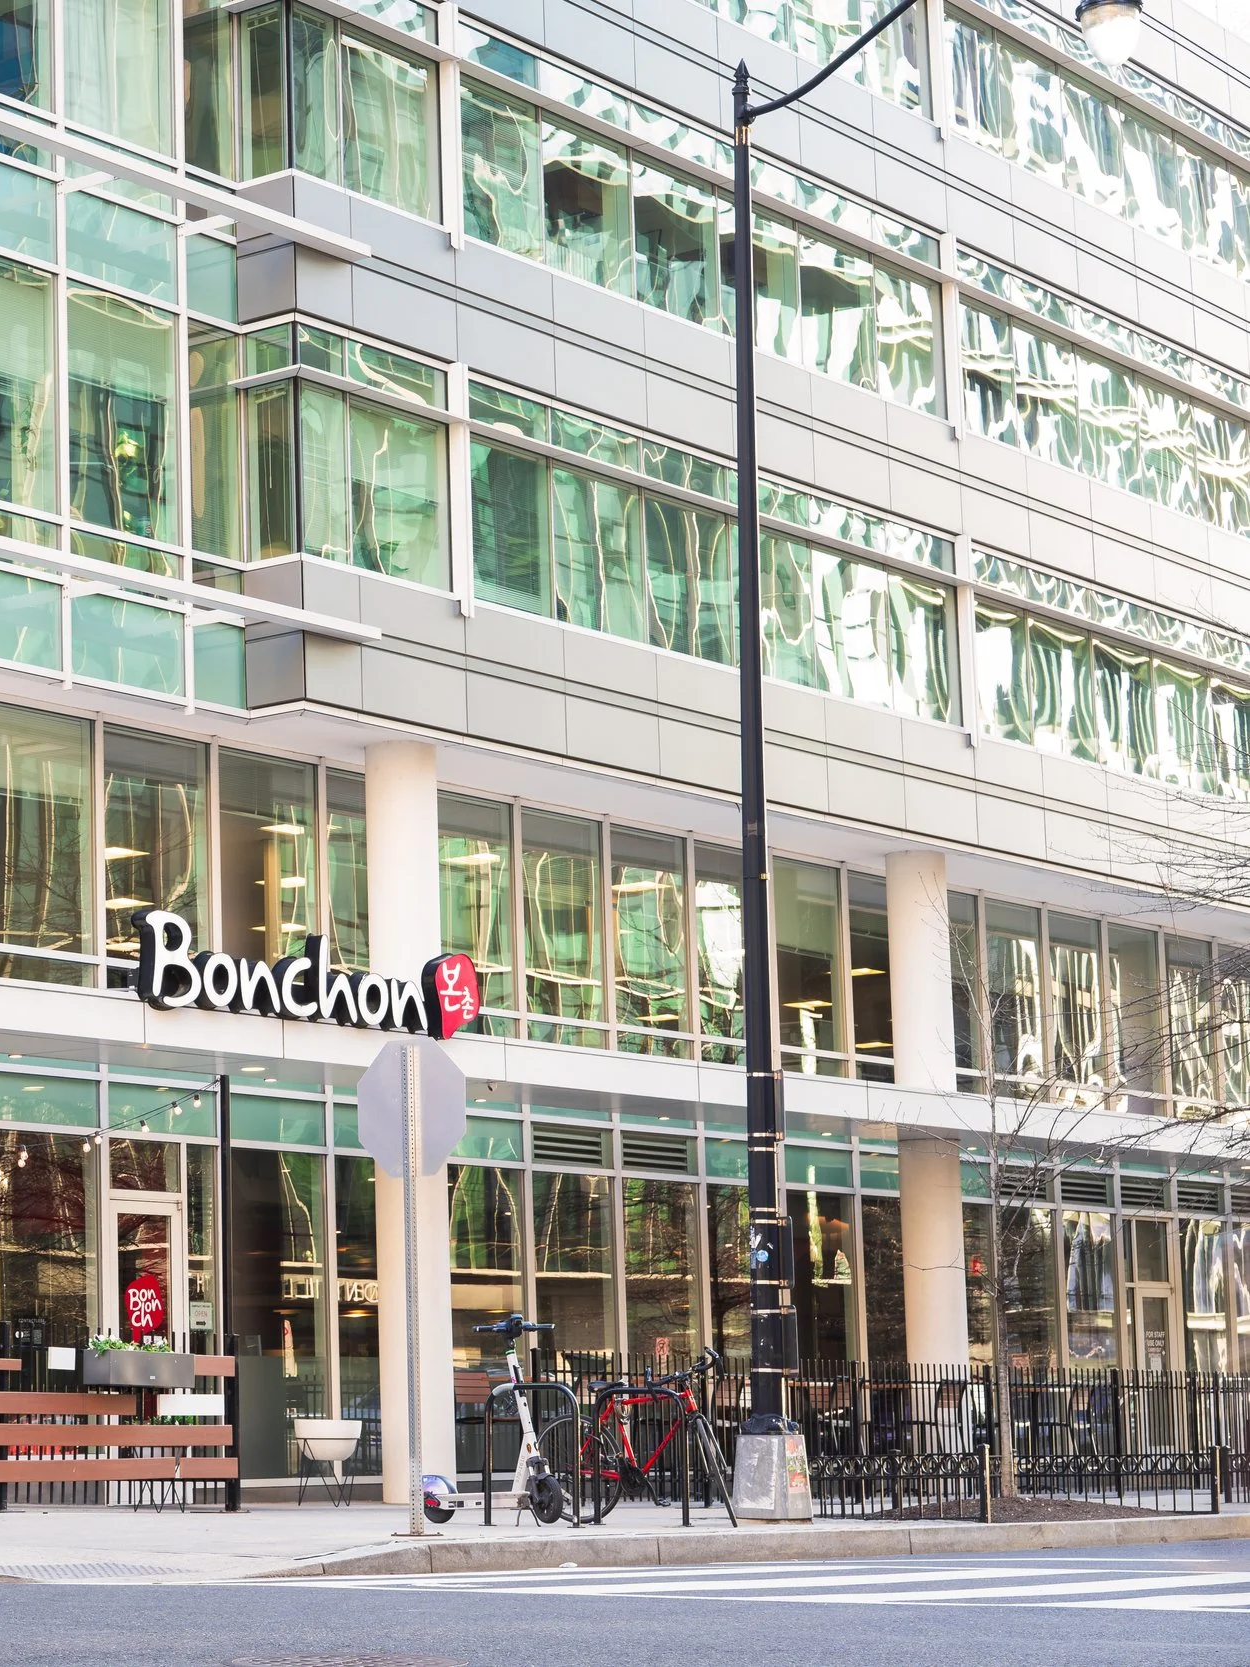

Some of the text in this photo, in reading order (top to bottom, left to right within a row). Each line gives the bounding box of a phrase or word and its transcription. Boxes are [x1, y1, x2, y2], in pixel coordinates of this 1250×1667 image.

[144, 909, 428, 1030] Bonchon
[440, 962, 475, 1019] 본촌
[1155, 1339, 1165, 1347] ONLY
